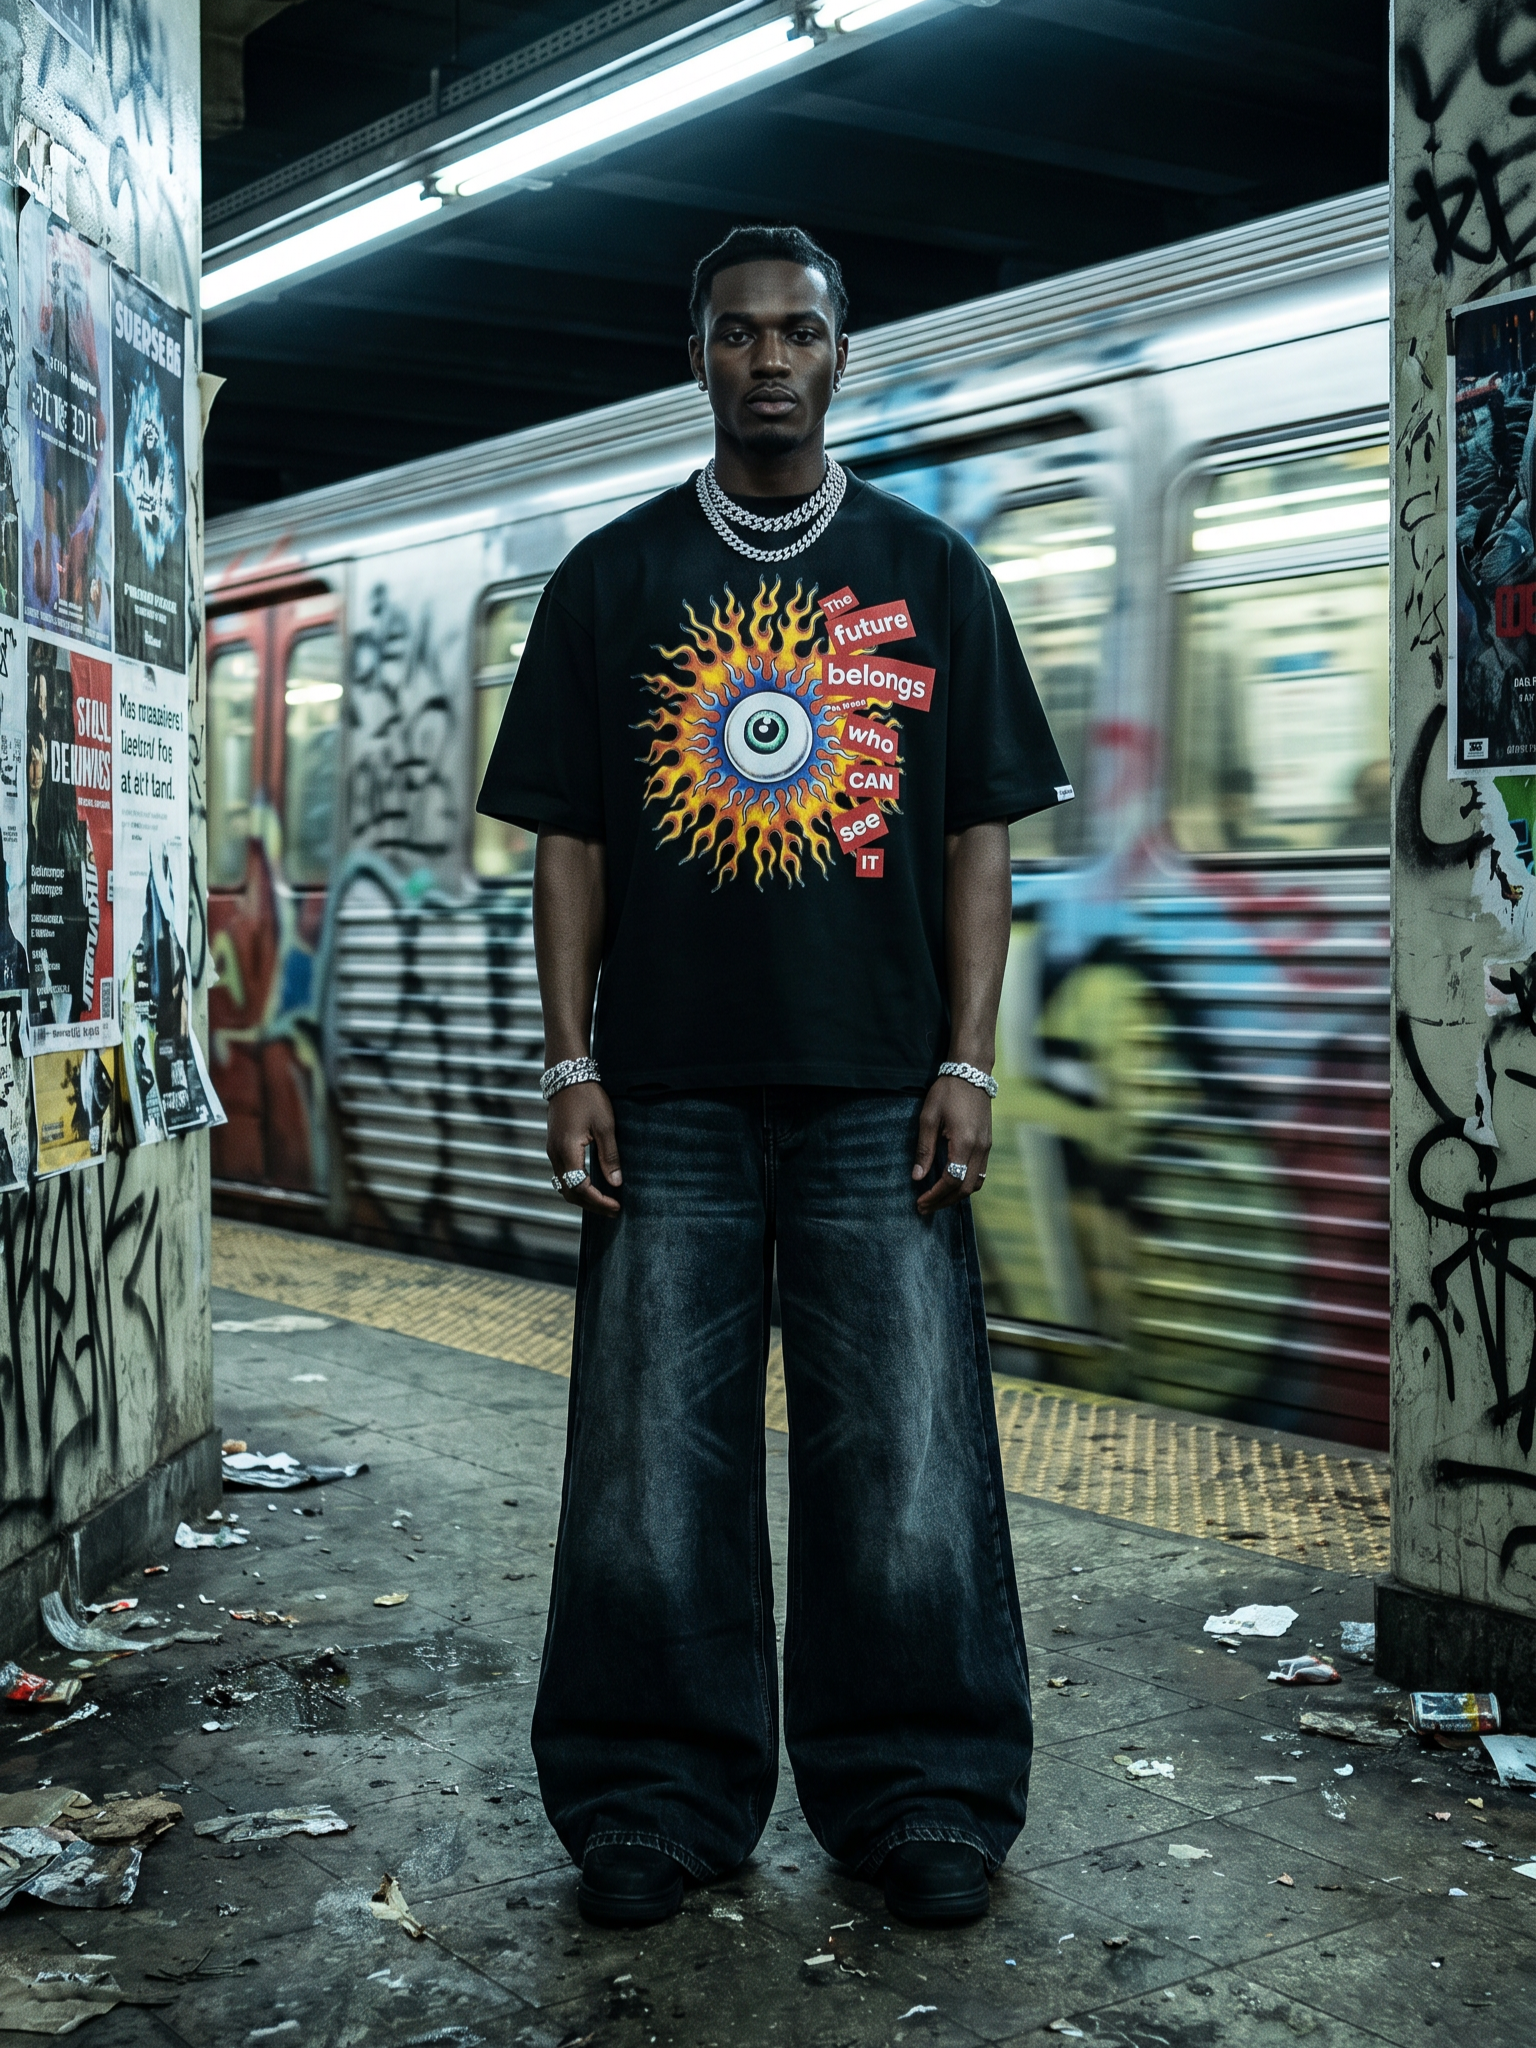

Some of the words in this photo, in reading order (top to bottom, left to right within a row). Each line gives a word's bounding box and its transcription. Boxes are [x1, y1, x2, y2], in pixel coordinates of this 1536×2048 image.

[823, 593, 853, 614] The
[834, 612, 909, 646] future
[828, 662, 926, 701] belongs
[848, 725, 894, 754] who
[849, 771, 893, 790] CAN
[839, 812, 881, 842] see
[861, 855, 879, 870] IT
